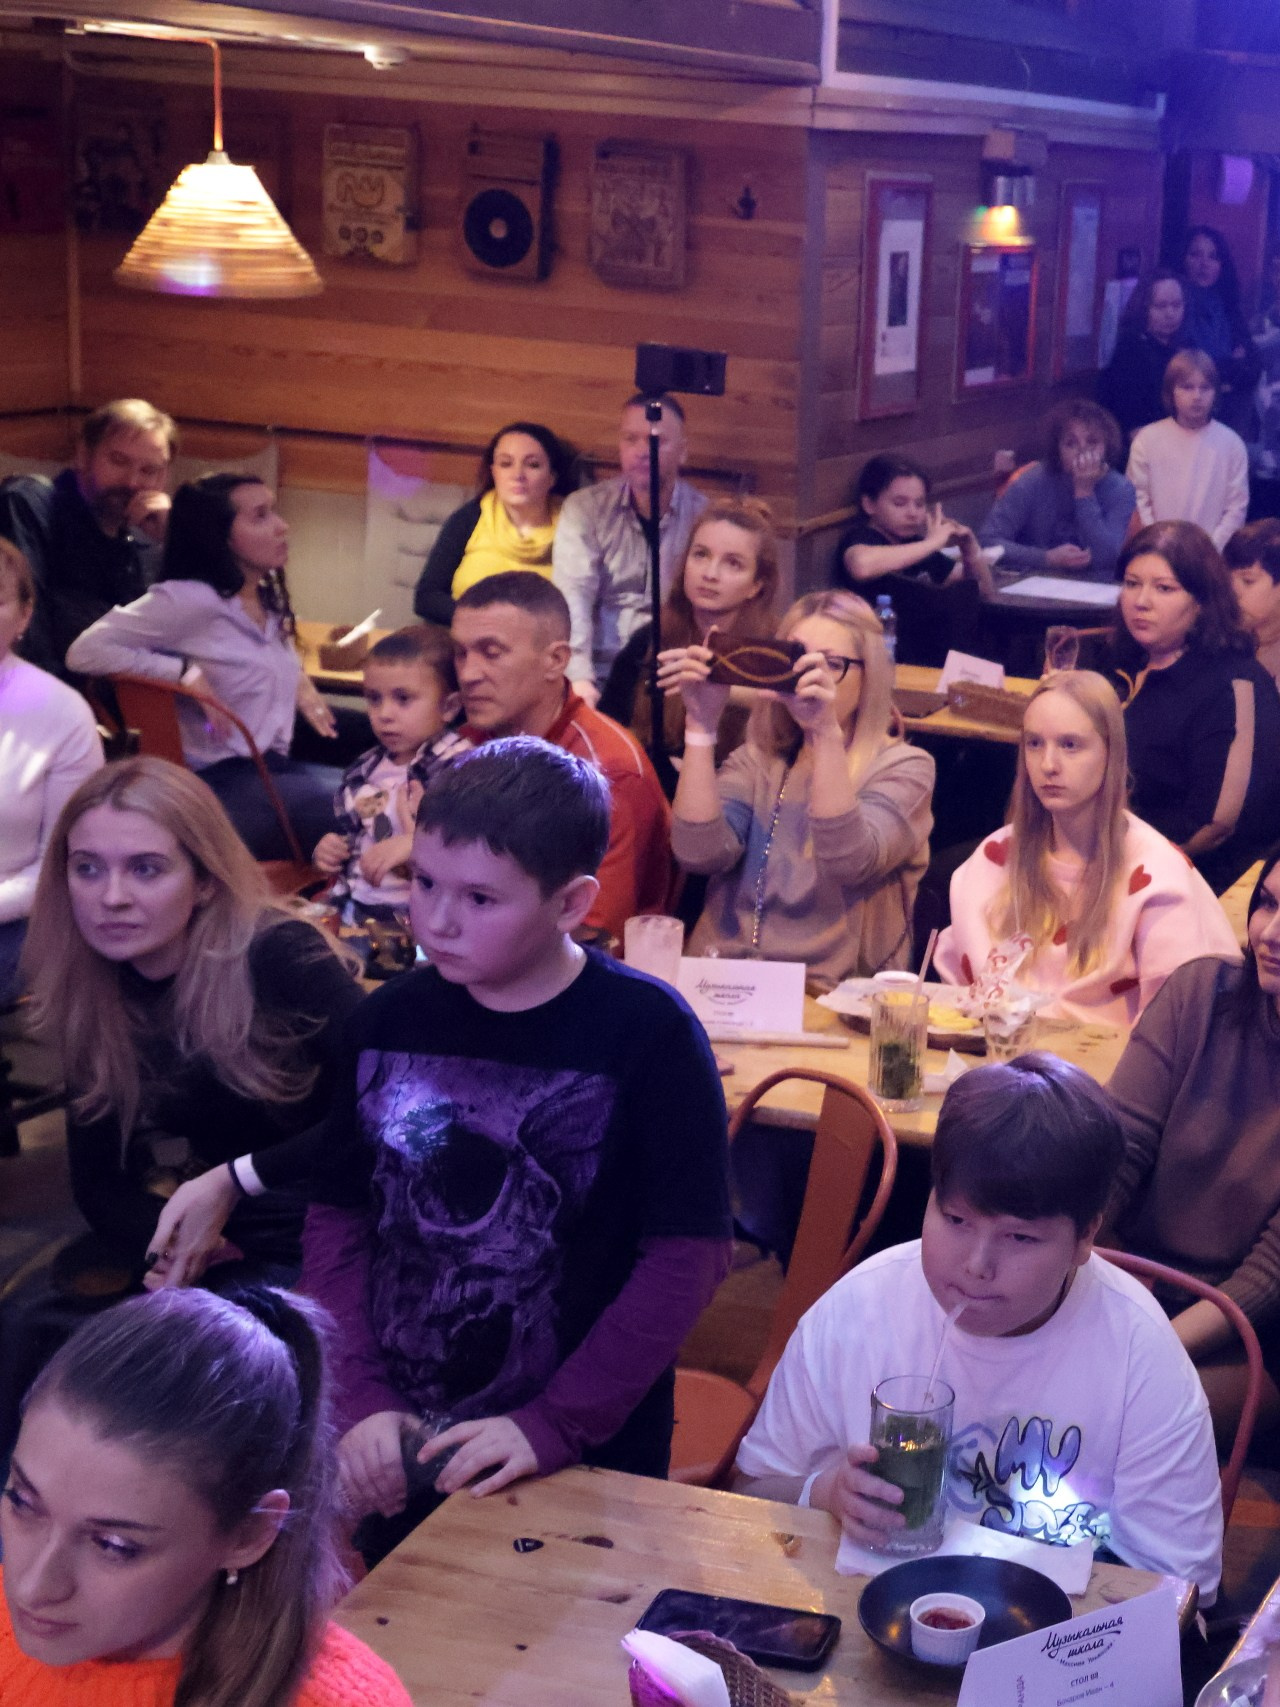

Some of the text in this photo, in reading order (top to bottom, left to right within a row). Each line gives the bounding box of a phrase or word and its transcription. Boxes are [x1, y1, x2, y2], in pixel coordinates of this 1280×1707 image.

[995, 1416, 1081, 1498] MY
[1041, 1616, 1123, 1659] Музыкальная
[1067, 1638, 1104, 1658] школа
[1070, 1675, 1089, 1687] СТОЛ
